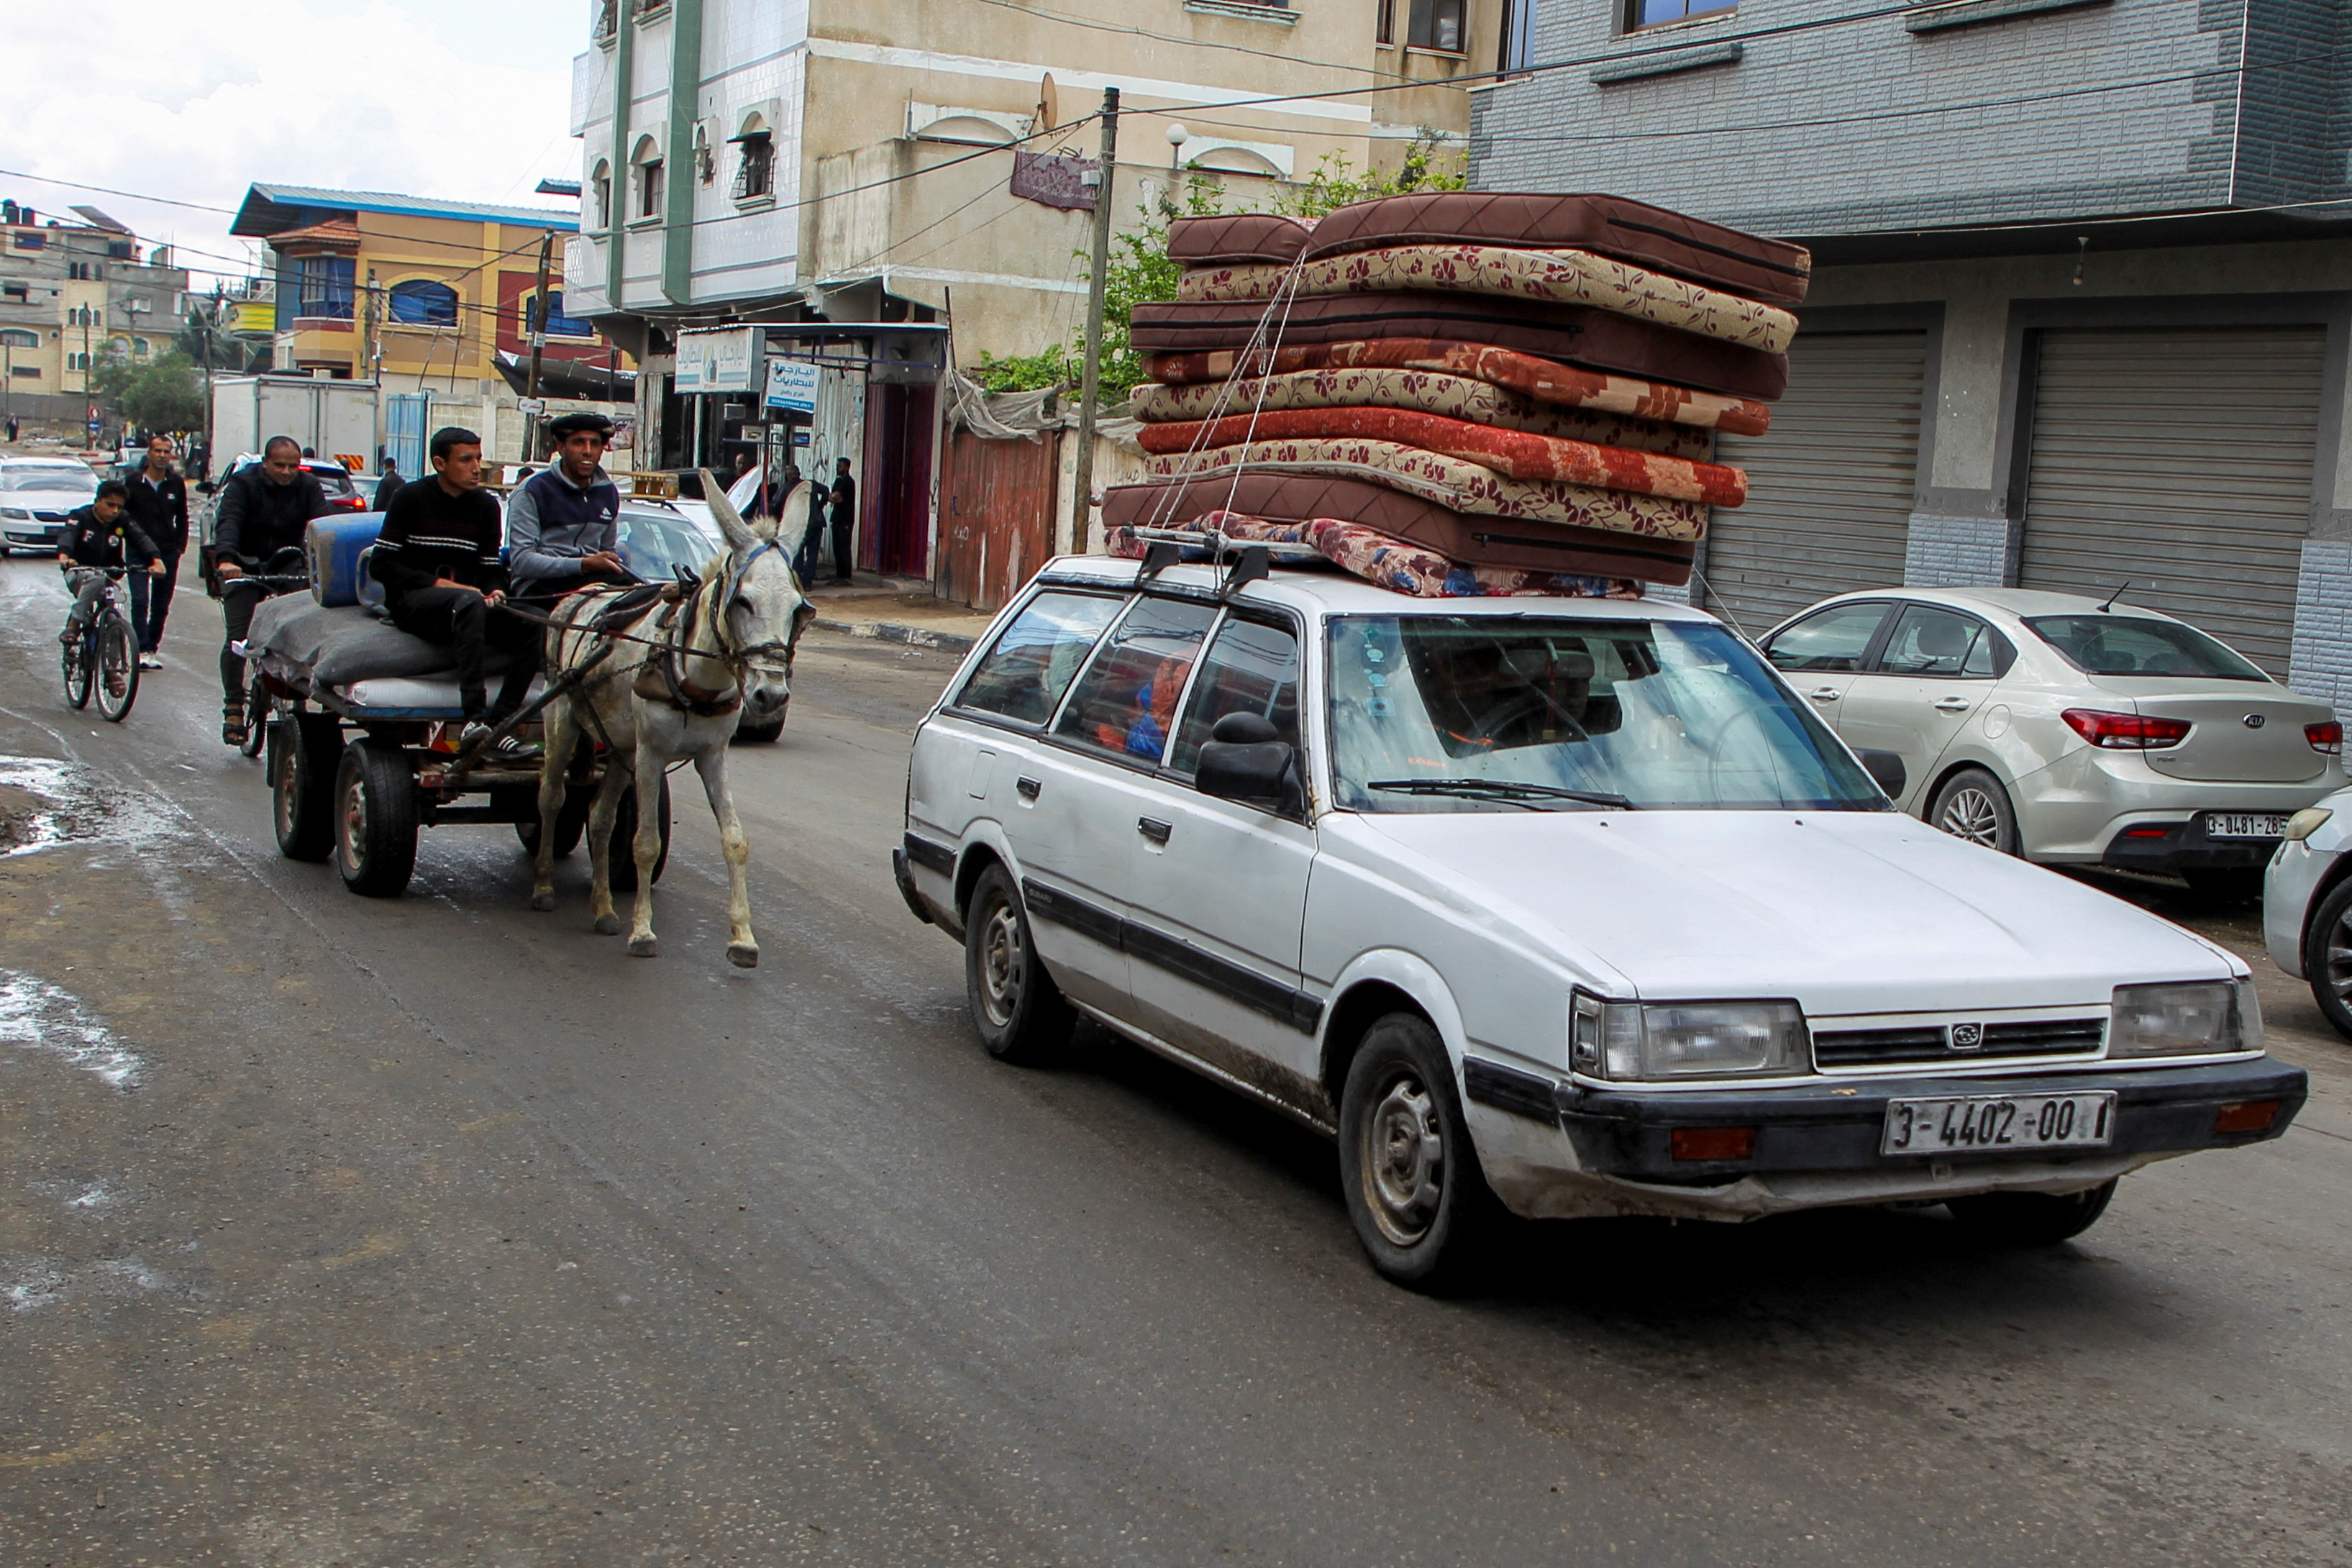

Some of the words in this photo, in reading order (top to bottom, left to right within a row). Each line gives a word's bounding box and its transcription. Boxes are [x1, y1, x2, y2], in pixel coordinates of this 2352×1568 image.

[774, 376, 814, 388] للبطاريات
[2248, 717, 2263, 726] KIA
[1029, 888, 1052, 903] SUBARU
